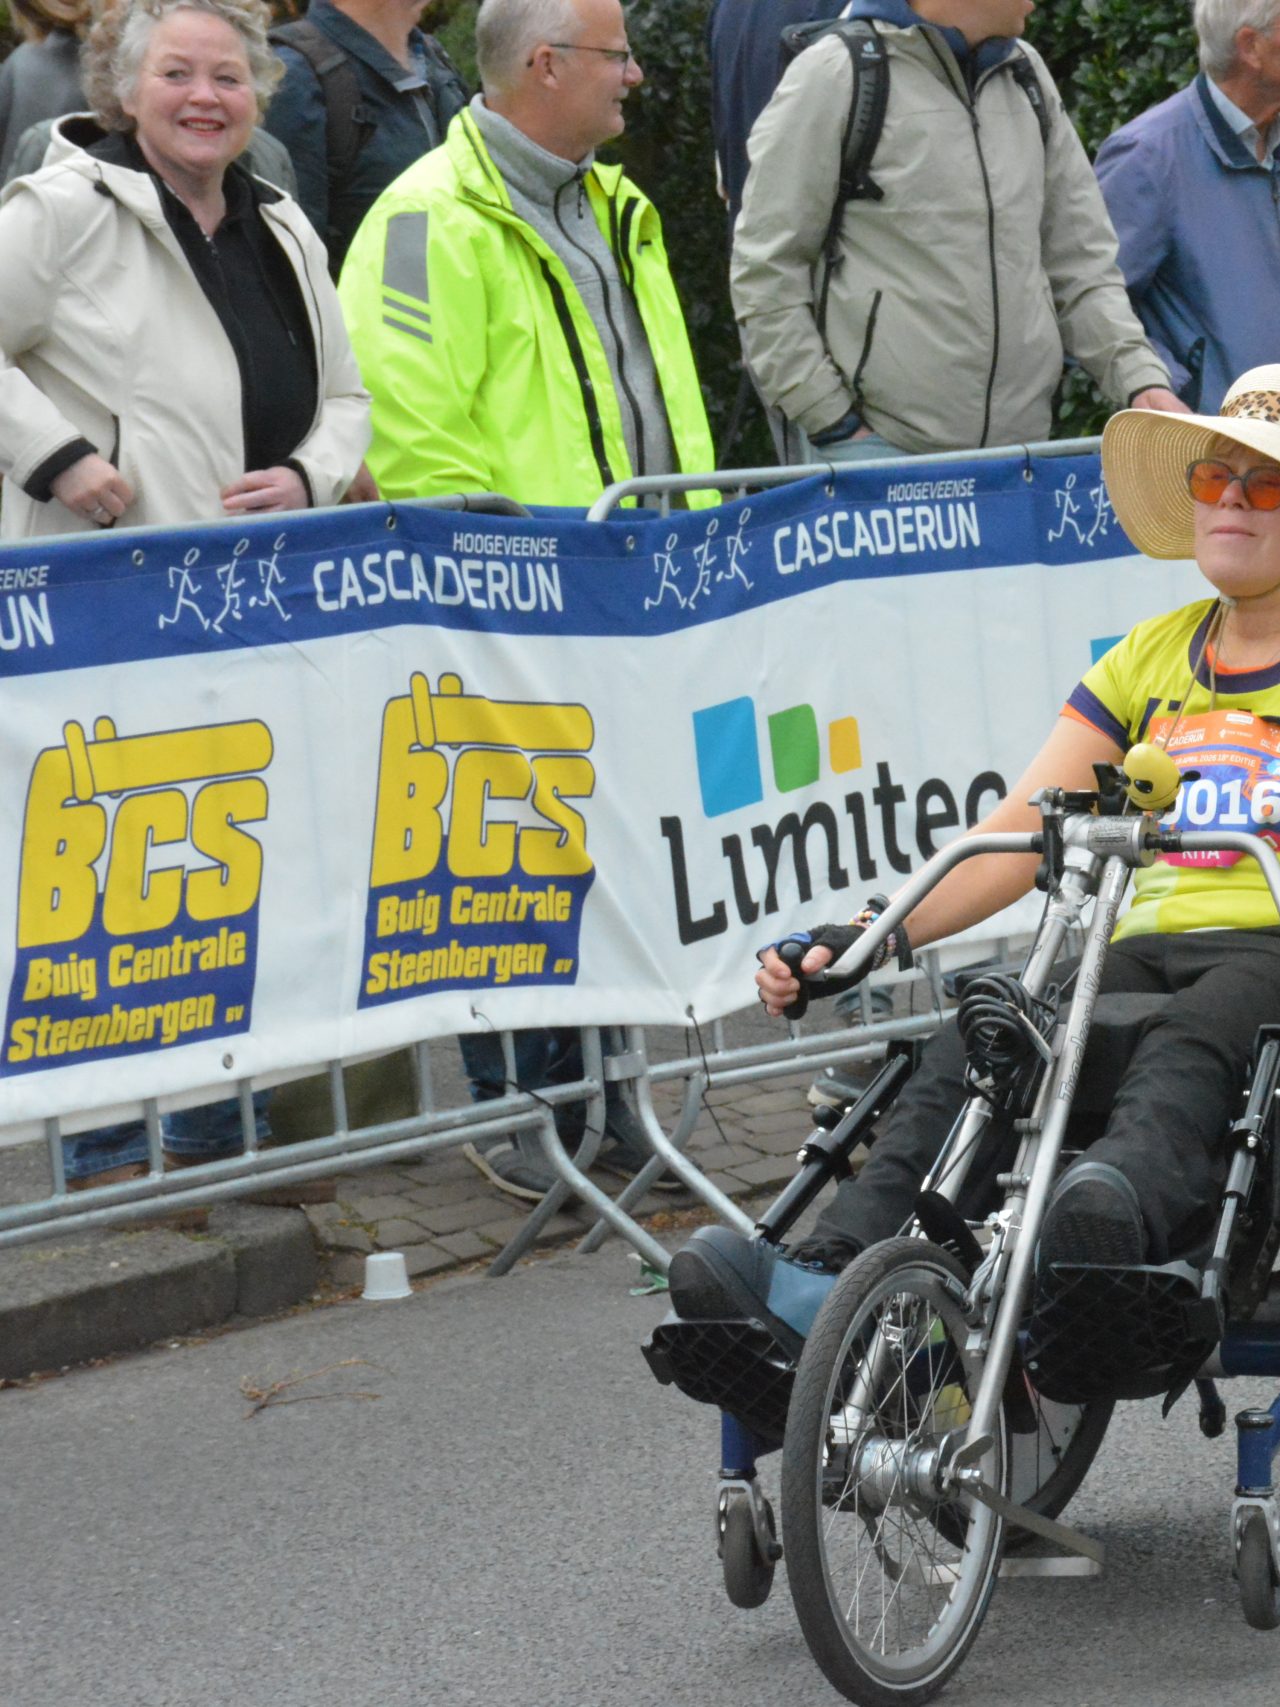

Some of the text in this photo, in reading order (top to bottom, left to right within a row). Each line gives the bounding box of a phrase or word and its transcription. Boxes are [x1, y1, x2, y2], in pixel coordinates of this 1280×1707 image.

[887, 478, 976, 502] HOOGEVEENSE
[453, 532, 558, 557] HOOGEVEENSE
[774, 502, 981, 575] CASCADERUN
[314, 550, 562, 612] CASCADERUN
[369, 715, 596, 888] BCS
[18, 748, 272, 948] BCS
[377, 885, 571, 938] Buig Centrale
[22, 927, 246, 1001] Buig Centrale
[365, 940, 547, 995] Steenbergen
[7, 991, 215, 1062] Steenbergen
